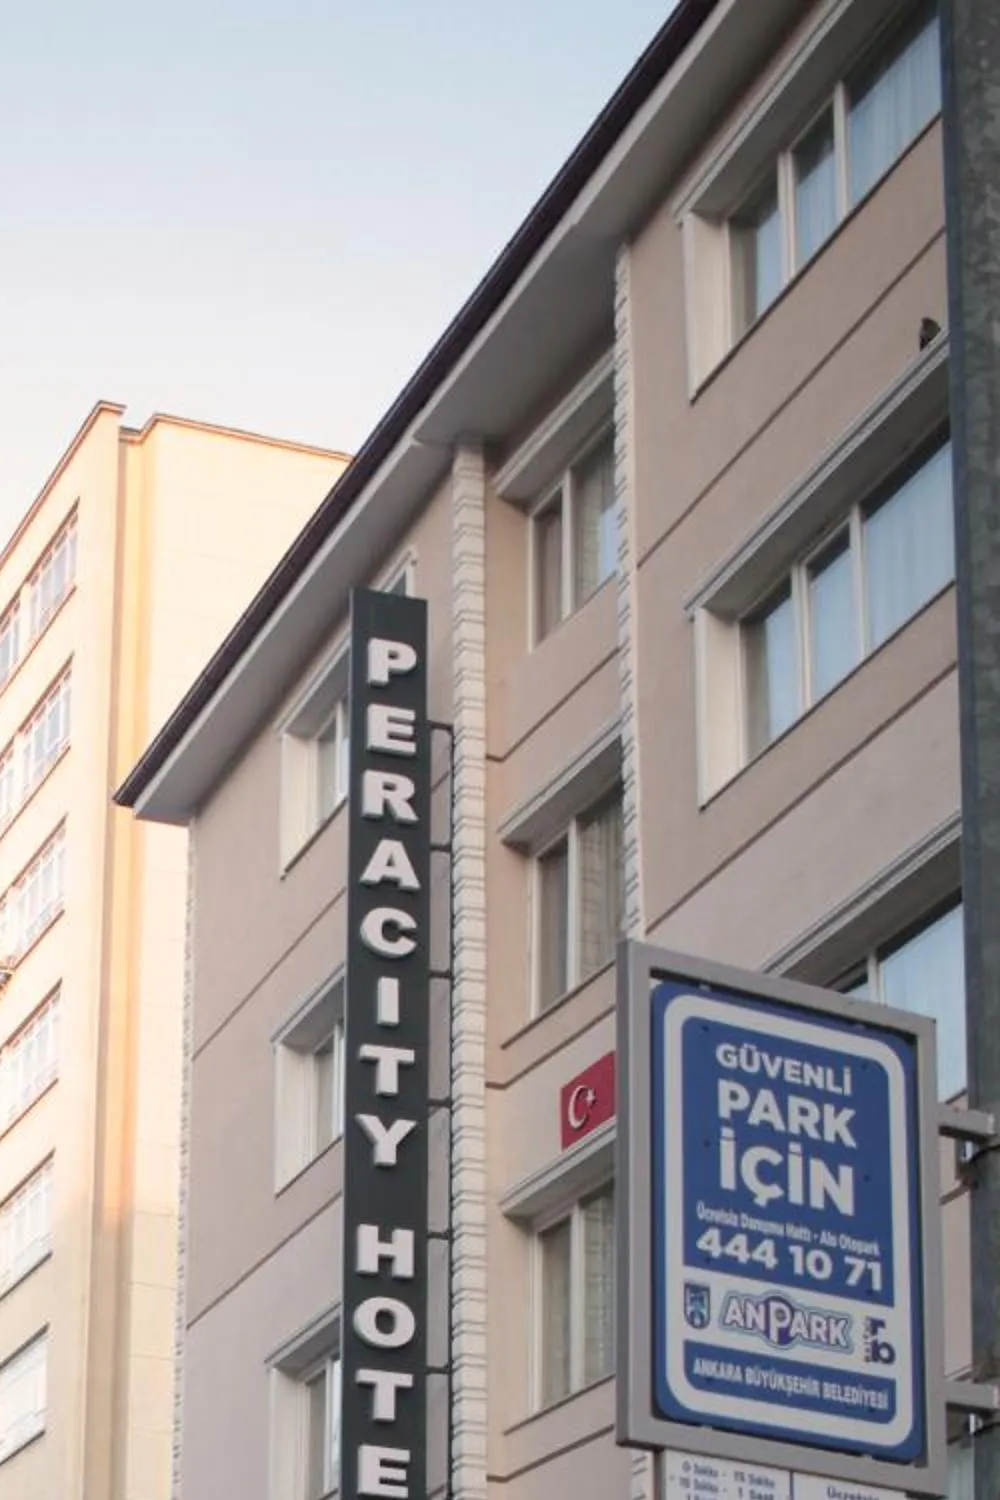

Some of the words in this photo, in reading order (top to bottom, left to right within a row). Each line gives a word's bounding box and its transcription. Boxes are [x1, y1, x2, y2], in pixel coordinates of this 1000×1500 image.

[355, 637, 420, 1167] PERACITY
[715, 1042, 852, 1097] GÜVENLİ
[717, 1078, 857, 1149] PARK
[719, 1126, 855, 1217] İÇİN
[696, 1226, 779, 1270] 444
[788, 1245, 833, 1280] 10
[844, 1255, 882, 1292] 71
[723, 1296, 849, 1348] ANPARK
[692, 1357, 743, 1382] ANKARA
[744, 1365, 821, 1397] BÜYÜKŞEHİR
[822, 1379, 890, 1410] BELEDİYESİ
